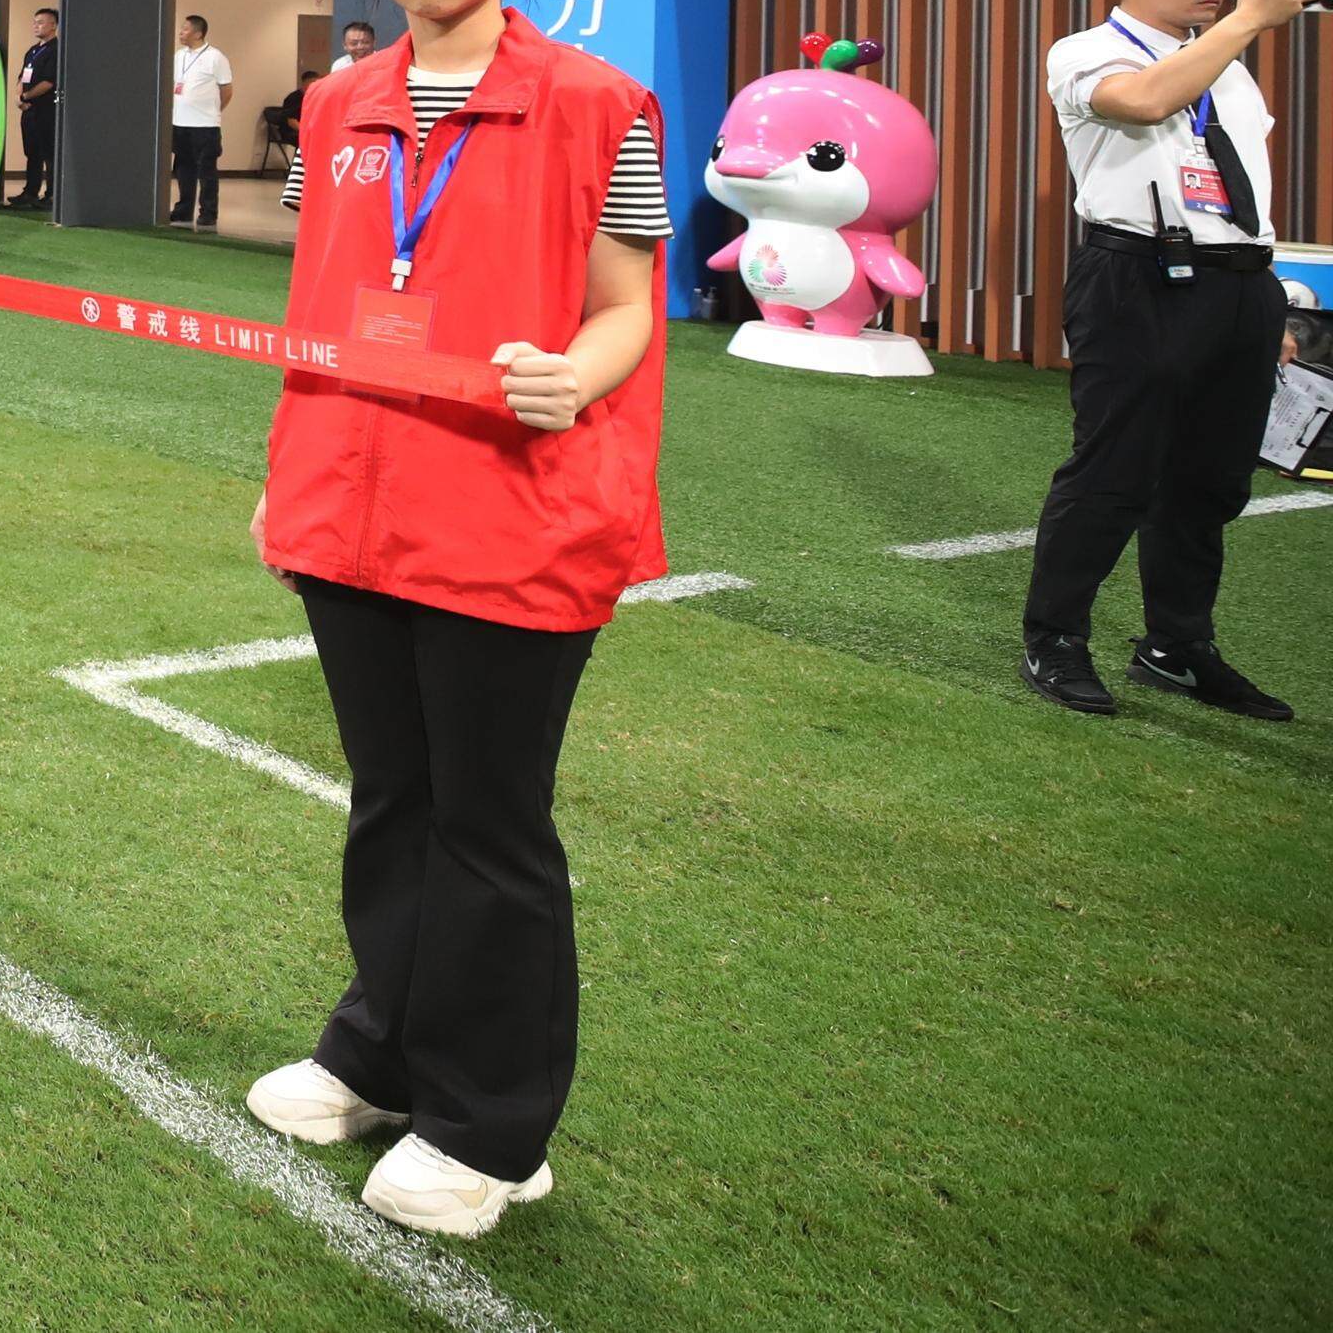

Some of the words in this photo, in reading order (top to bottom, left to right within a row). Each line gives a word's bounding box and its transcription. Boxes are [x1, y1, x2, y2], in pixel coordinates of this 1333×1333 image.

[116, 302, 201, 344] 警戒线
[214, 323, 275, 355] LIMIT
[285, 336, 339, 368] LINE
